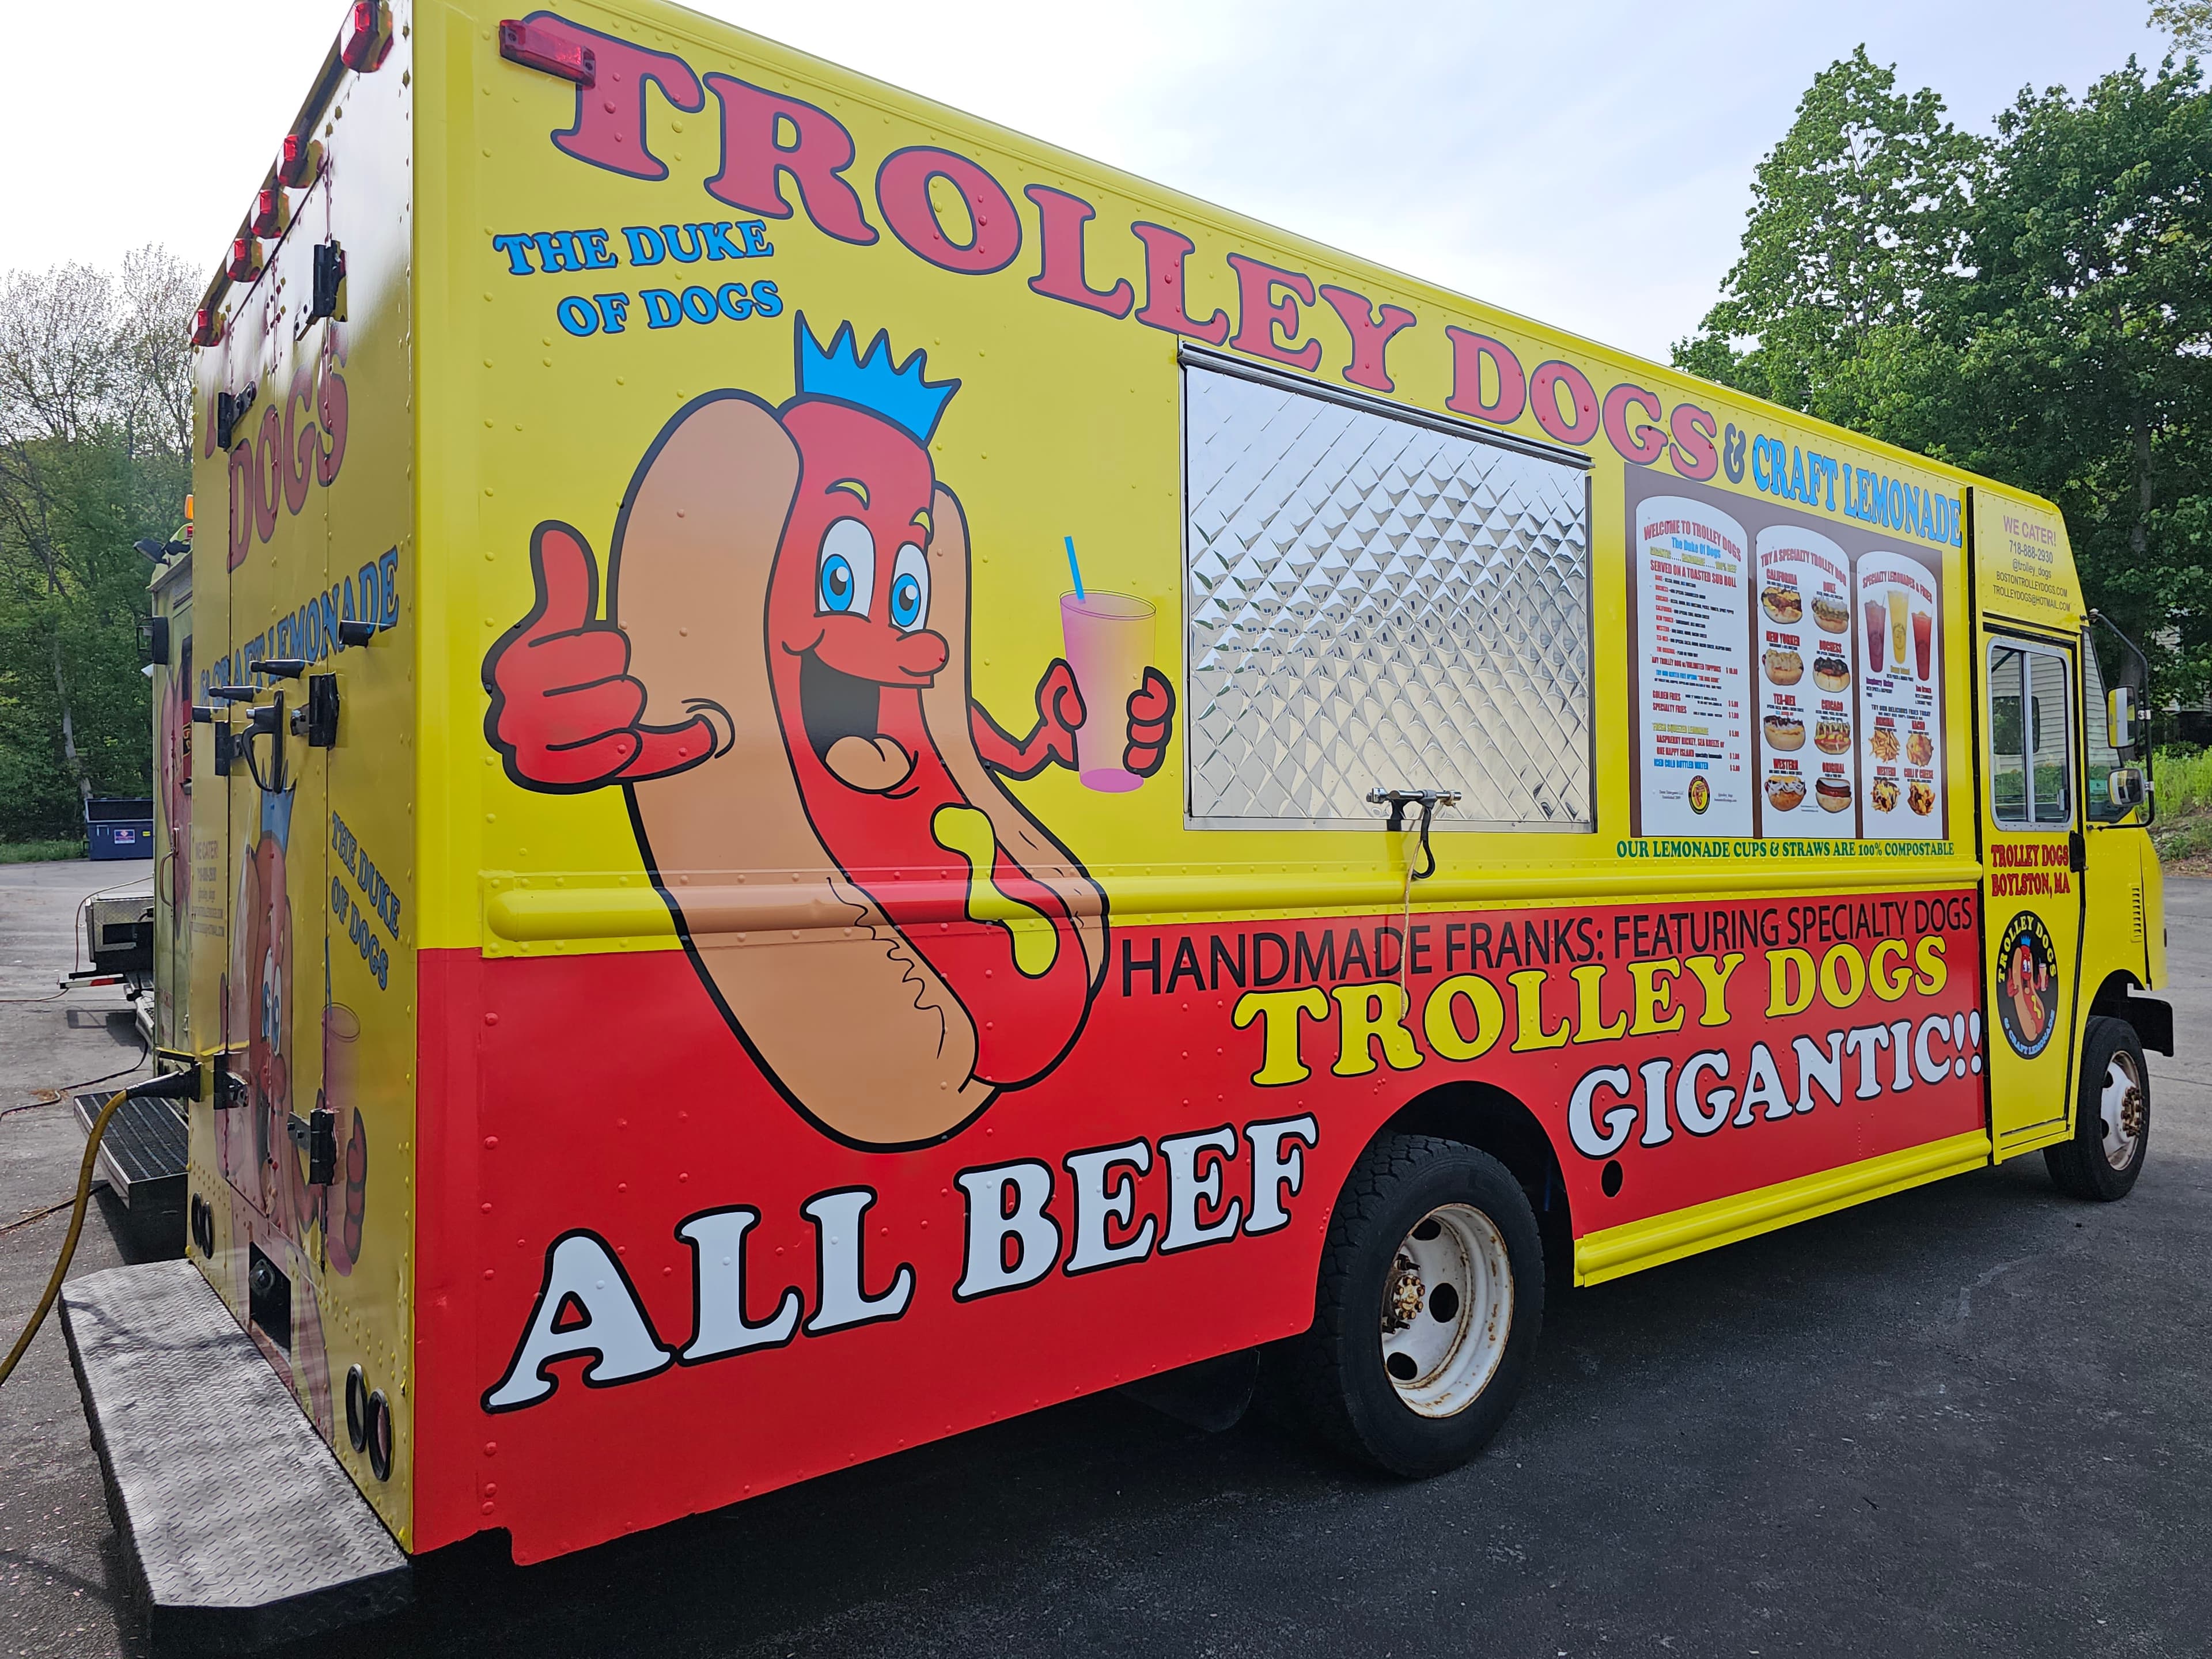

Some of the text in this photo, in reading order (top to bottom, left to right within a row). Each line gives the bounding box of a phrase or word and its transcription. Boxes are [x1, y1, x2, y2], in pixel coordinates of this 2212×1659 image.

[493, 219, 774, 275] THE DUKE
[517, 10, 1963, 548] TROLLEY DOGS & CRAFT LEMONADE
[556, 279, 784, 338] OF DOGS
[227, 323, 349, 574] DOGS
[1644, 520, 1680, 541] WELCOME
[1681, 520, 1691, 535] TO
[1692, 522, 1721, 547] TROLLEY
[1722, 535, 1741, 562] DOGS
[1672, 536, 1683, 550] The
[2003, 515, 2056, 547] WE CATER!
[1760, 551, 1772, 567] TRY
[1774, 550, 1778, 563] A
[1779, 548, 1810, 563] SPECIALTY
[1810, 551, 1835, 576] TROLLEY
[2009, 540, 2054, 564] 718-888-2930
[1650, 559, 1672, 574] SERVED
[1673, 565, 1681, 576] ON
[1681, 567, 1686, 578] A
[1687, 567, 1711, 582] TOASTED
[1712, 573, 1723, 585] SUB
[1724, 575, 1737, 588] ROLL
[1766, 568, 1797, 585] CALIFORNIA
[1862, 571, 1887, 589] SPECIALTY
[1996, 571, 2067, 597] BOSTONTROLLEYDOGS.COM
[2012, 558, 2052, 580] @trolley_dogs
[1993, 584, 2070, 612] TROLLEYDOGS@HOTMAIL.COM
[1653, 690, 1668, 699] GOLDEN
[1669, 692, 1681, 701] FRIES
[1653, 703, 1675, 713] SPECIALTY
[1675, 705, 1687, 714] FRIES
[1616, 840, 1955, 858] OUR LEMONADE CUPS & STRAWS ARE 100% COMPOSTABLE
[1991, 843, 2069, 868] TROLLEY DOGS
[331, 809, 400, 942] THE DUKE
[1991, 872, 2071, 899] BOYLSTON, MA
[331, 875, 389, 991] OF DOGS
[1122, 896, 1972, 997] HANDMADE FRANKS: FEATURING SPECIALTY DOGS
[1998, 915, 2057, 983] TROLLEY DOGS
[1231, 934, 1948, 1088] TROLLEY DOGS
[2009, 1029, 2028, 1055] CRAFT
[2028, 1009, 2055, 1055] LEMONADE
[1567, 1007, 1982, 1159] GIGANTIC!!
[480, 1112, 1319, 1414] ALL BEEF
